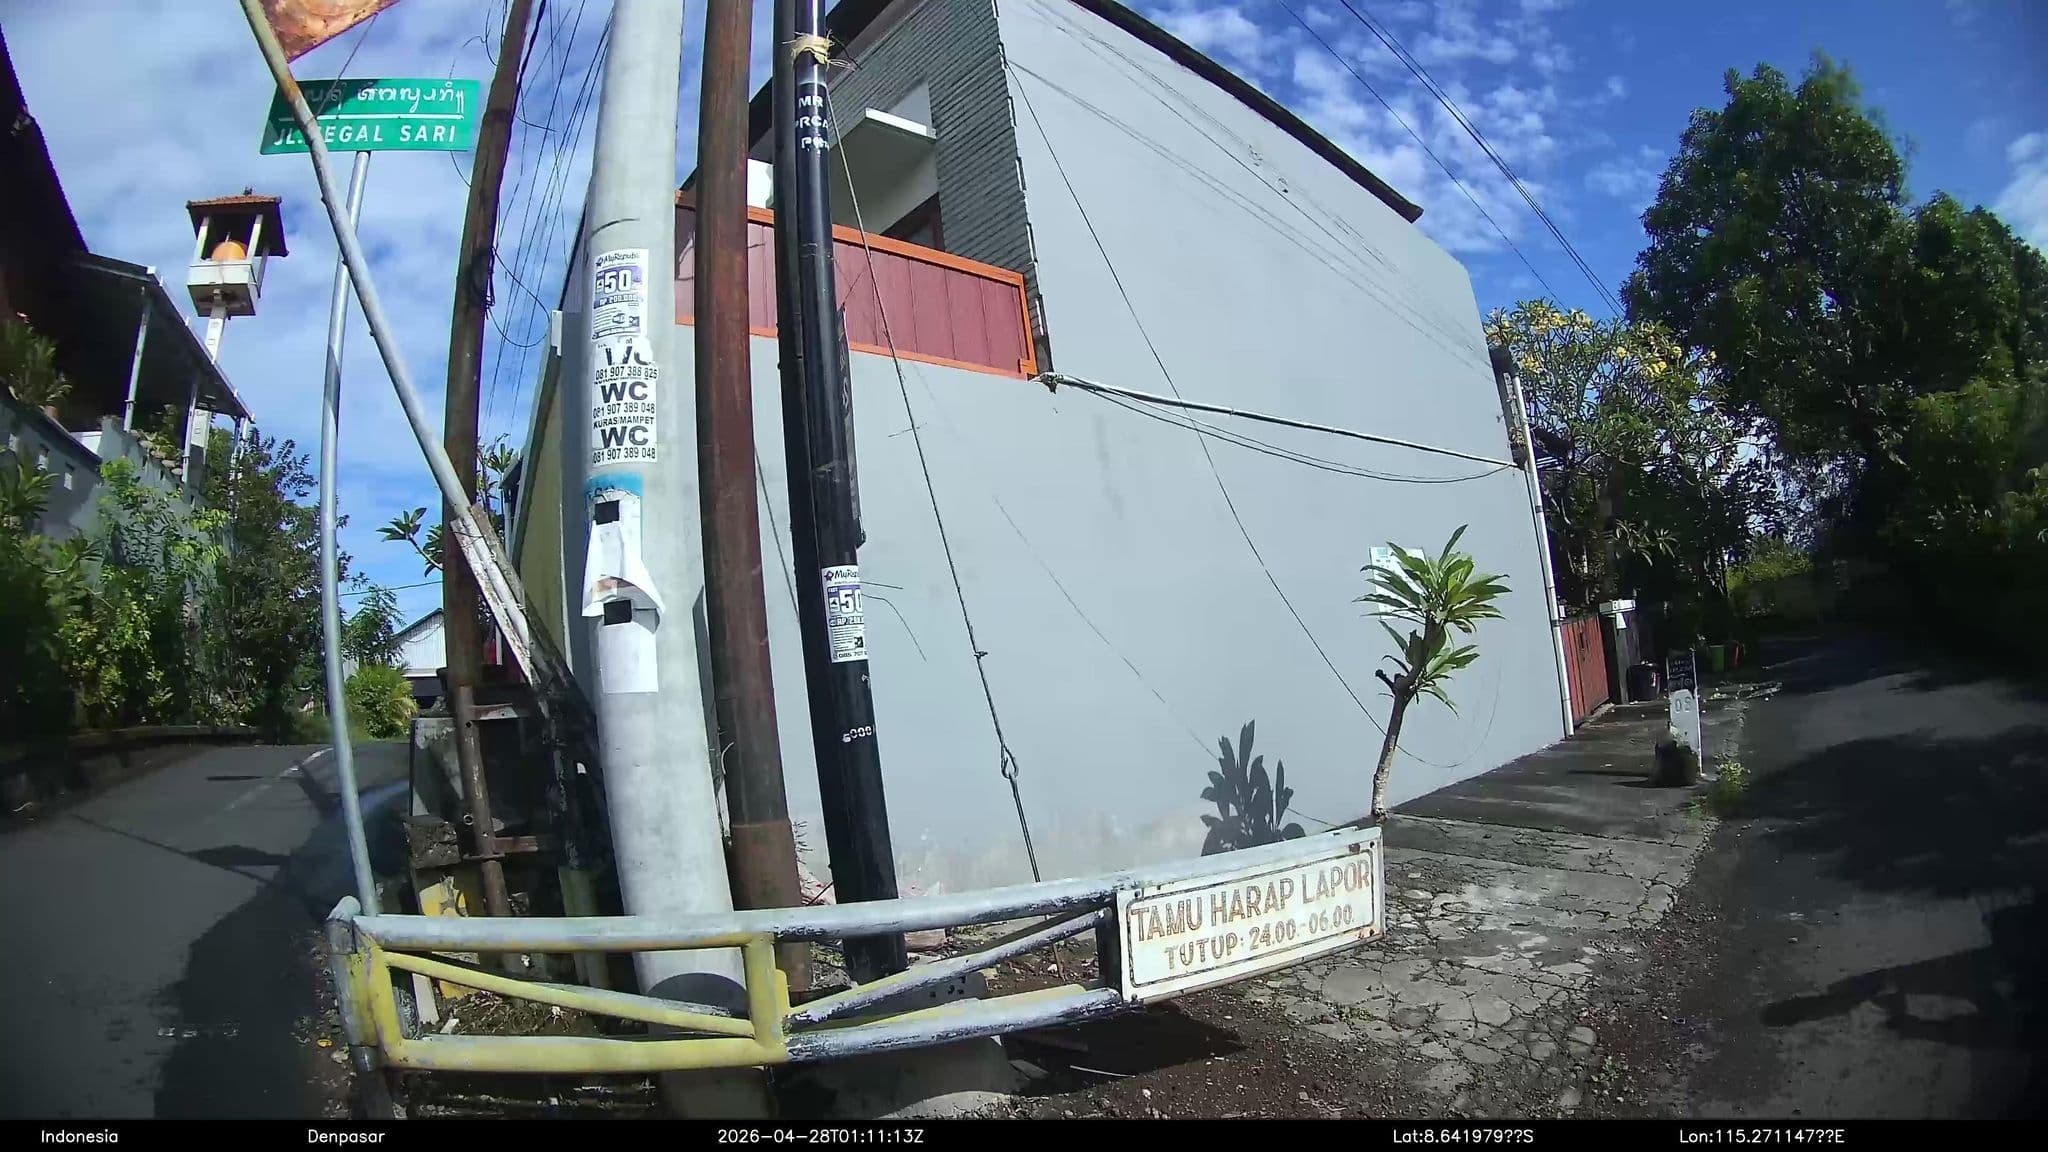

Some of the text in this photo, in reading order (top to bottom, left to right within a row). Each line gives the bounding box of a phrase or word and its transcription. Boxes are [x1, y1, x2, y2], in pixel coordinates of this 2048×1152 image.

[320, 124, 384, 143] EGAL
[400, 124, 455, 142] SARI
[610, 366, 625, 377] 907
[600, 381, 648, 403] WC
[607, 403, 621, 415] 907
[624, 402, 639, 413] 389
[641, 402, 655, 414] 048
[593, 416, 655, 429] KURAS MAMPET
[600, 425, 649, 449] WC
[607, 447, 621, 460] 907
[624, 447, 639, 459] 389
[642, 447, 656, 459] 048
[1130, 859, 1369, 942] TAMU HARAP LAPOR
